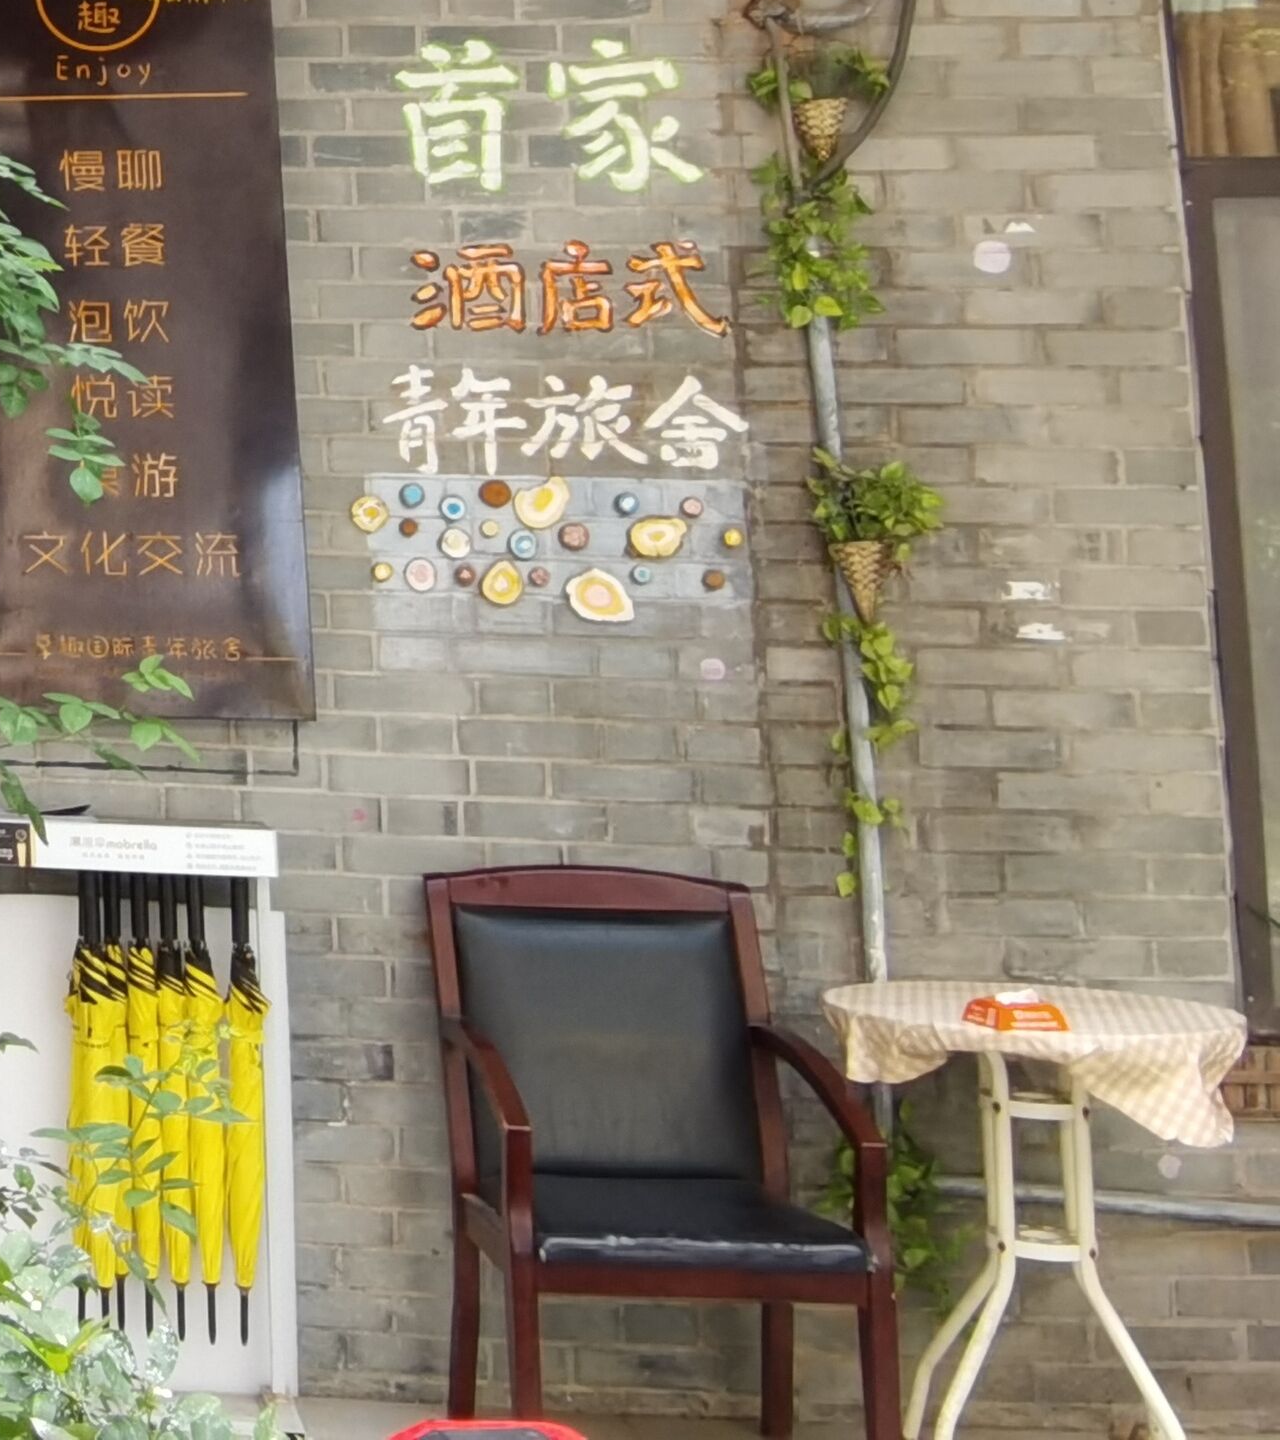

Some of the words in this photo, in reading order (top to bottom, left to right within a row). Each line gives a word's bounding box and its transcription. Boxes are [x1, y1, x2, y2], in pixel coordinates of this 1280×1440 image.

[56, 56, 153, 88] Enjoy
[59, 148, 163, 192] 慢聊
[64, 223, 166, 267] 轻餐
[409, 239, 730, 338] 酒店式
[69, 299, 170, 344] 泡饮
[381, 363, 749, 476] 青年旅舍
[23, 531, 241, 578] 文化交流
